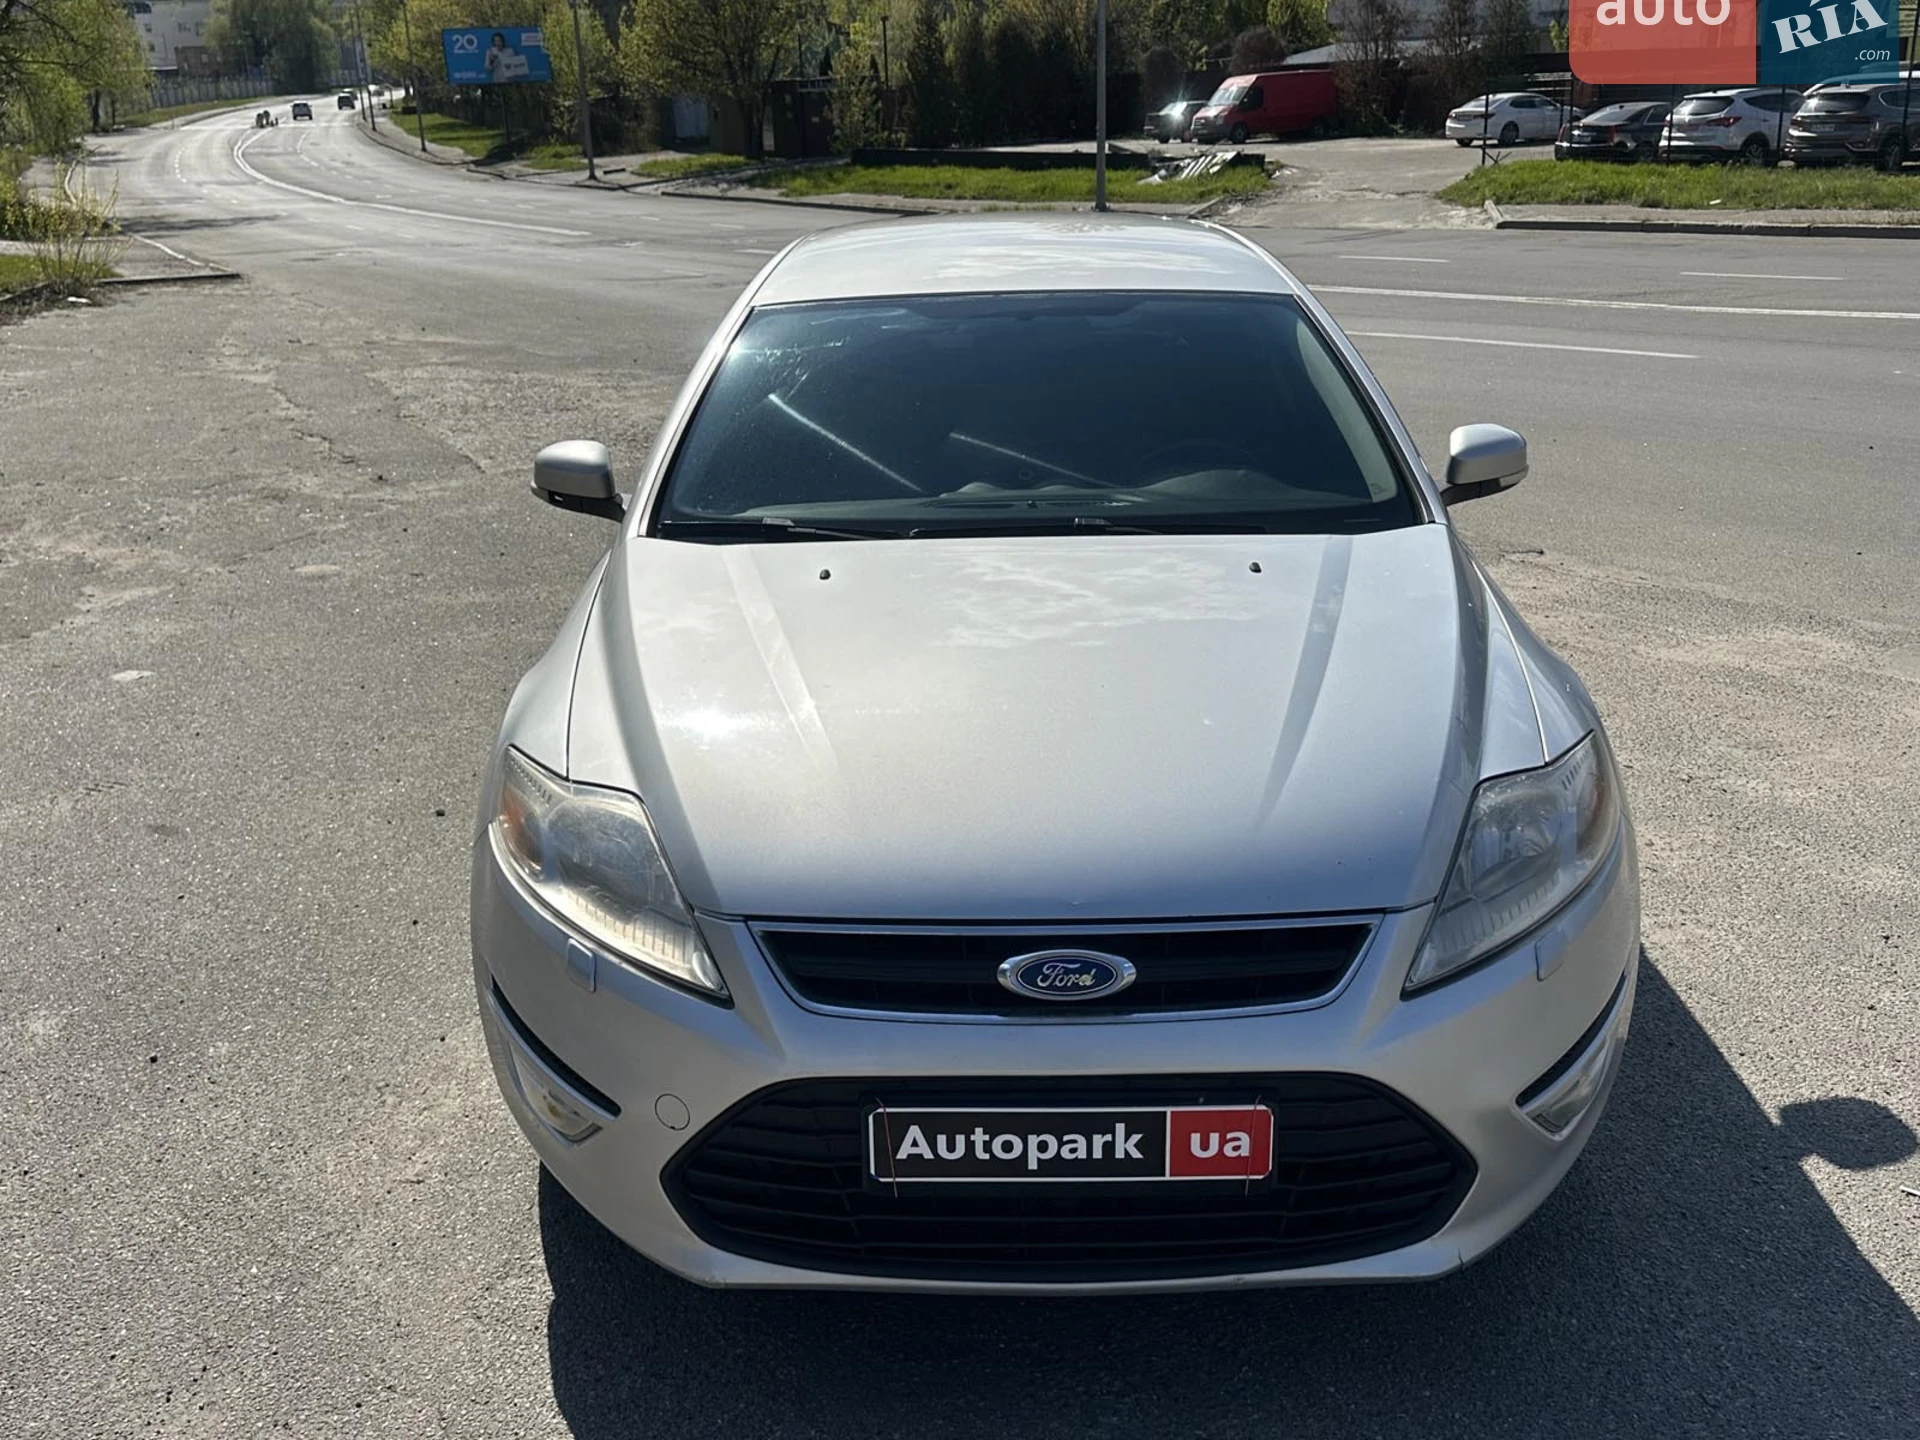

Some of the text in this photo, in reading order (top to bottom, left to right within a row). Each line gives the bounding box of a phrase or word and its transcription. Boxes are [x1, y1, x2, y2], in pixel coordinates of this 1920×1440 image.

[452, 34, 478, 50] 20
[1037, 962, 1097, 987] Ford
[895, 1123, 1251, 1170] Autopark ua
